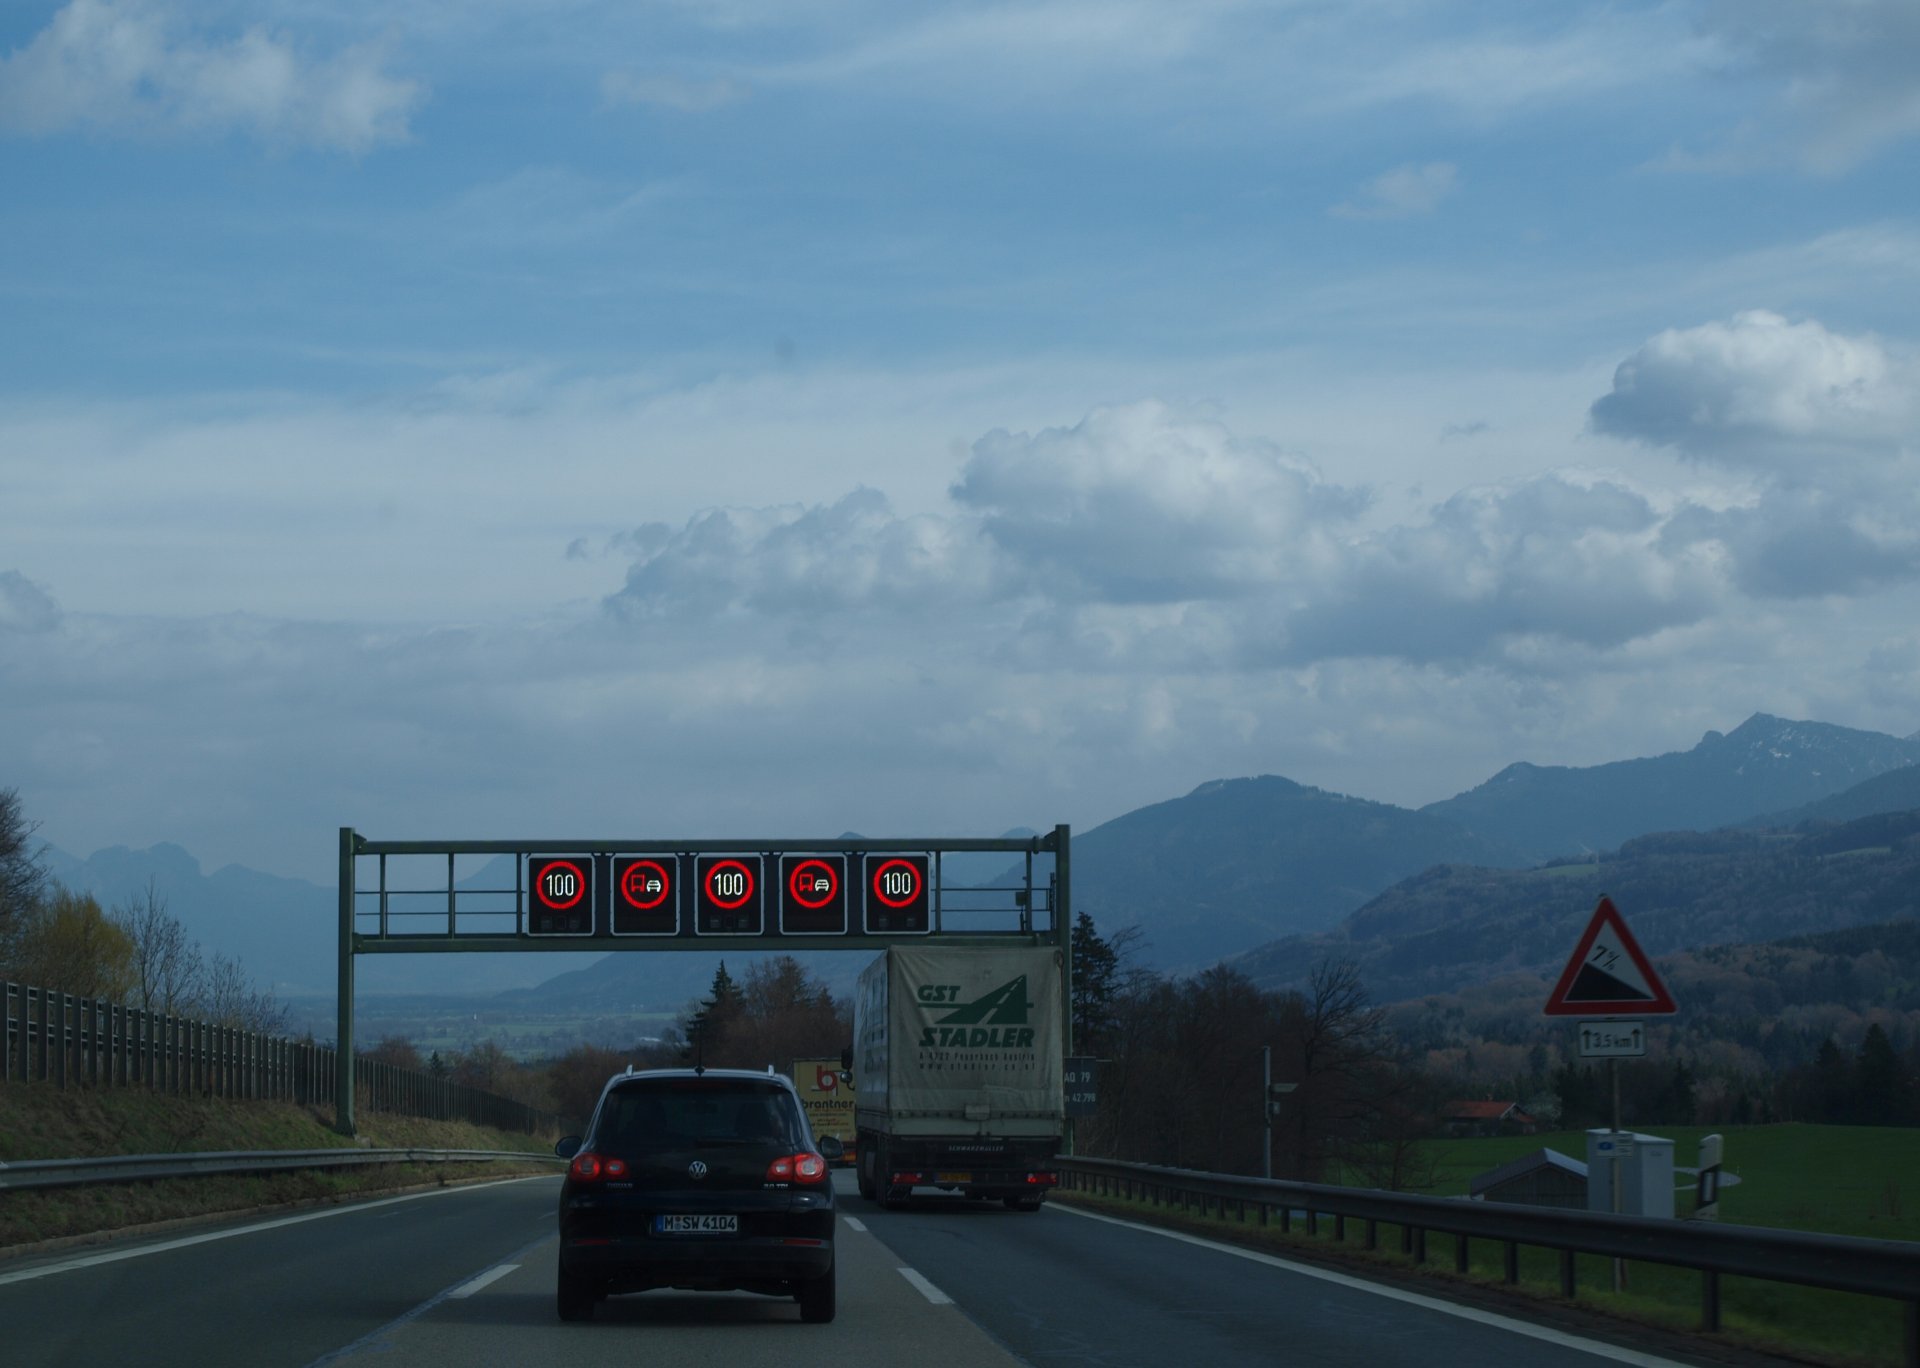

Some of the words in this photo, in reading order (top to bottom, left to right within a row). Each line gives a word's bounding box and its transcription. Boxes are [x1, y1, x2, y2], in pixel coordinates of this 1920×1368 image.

[545, 873, 575, 897] 100
[714, 872, 744, 896] 100
[883, 872, 912, 895] 100
[917, 985, 961, 1002] GST
[918, 1027, 1035, 1048] STADLER
[682, 1216, 700, 1230] SW
[702, 1216, 736, 1230] 4104
